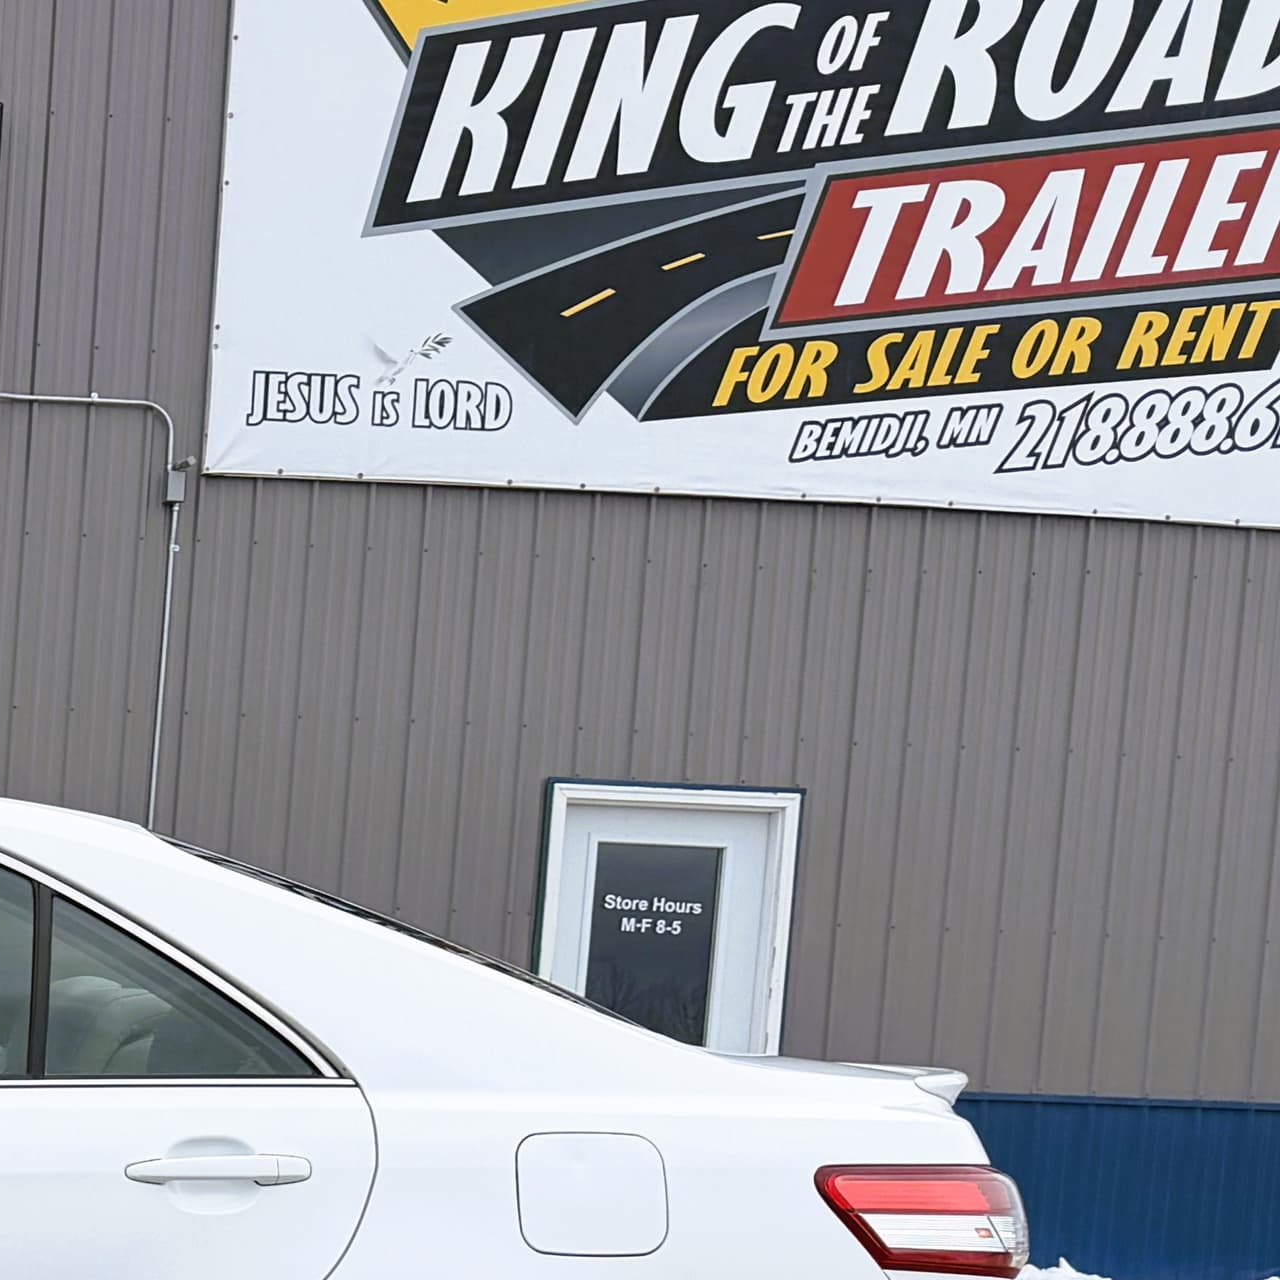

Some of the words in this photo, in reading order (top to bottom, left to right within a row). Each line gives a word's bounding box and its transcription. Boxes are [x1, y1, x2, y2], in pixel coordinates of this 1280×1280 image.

[816, 11, 890, 76] OF
[406, 2, 802, 203] KING
[776, 84, 880, 153] THE
[833, 150, 1280, 307] TRAILE
[711, 339, 839, 408] FOR
[852, 324, 1003, 395] SALE
[1011, 316, 1103, 379] OR
[1116, 300, 1280, 370] RENT
[246, 370, 360, 426] JESUS
[412, 378, 513, 431] LORD
[788, 408, 928, 463] BEMIDJI,
[936, 403, 1005, 450] MN
[993, 378, 1280, 474] 218.888.6
[604, 894, 648, 912] Store
[652, 897, 703, 914] Hours
[620, 917, 652, 933] M-F
[655, 920, 682, 935] 8-5
